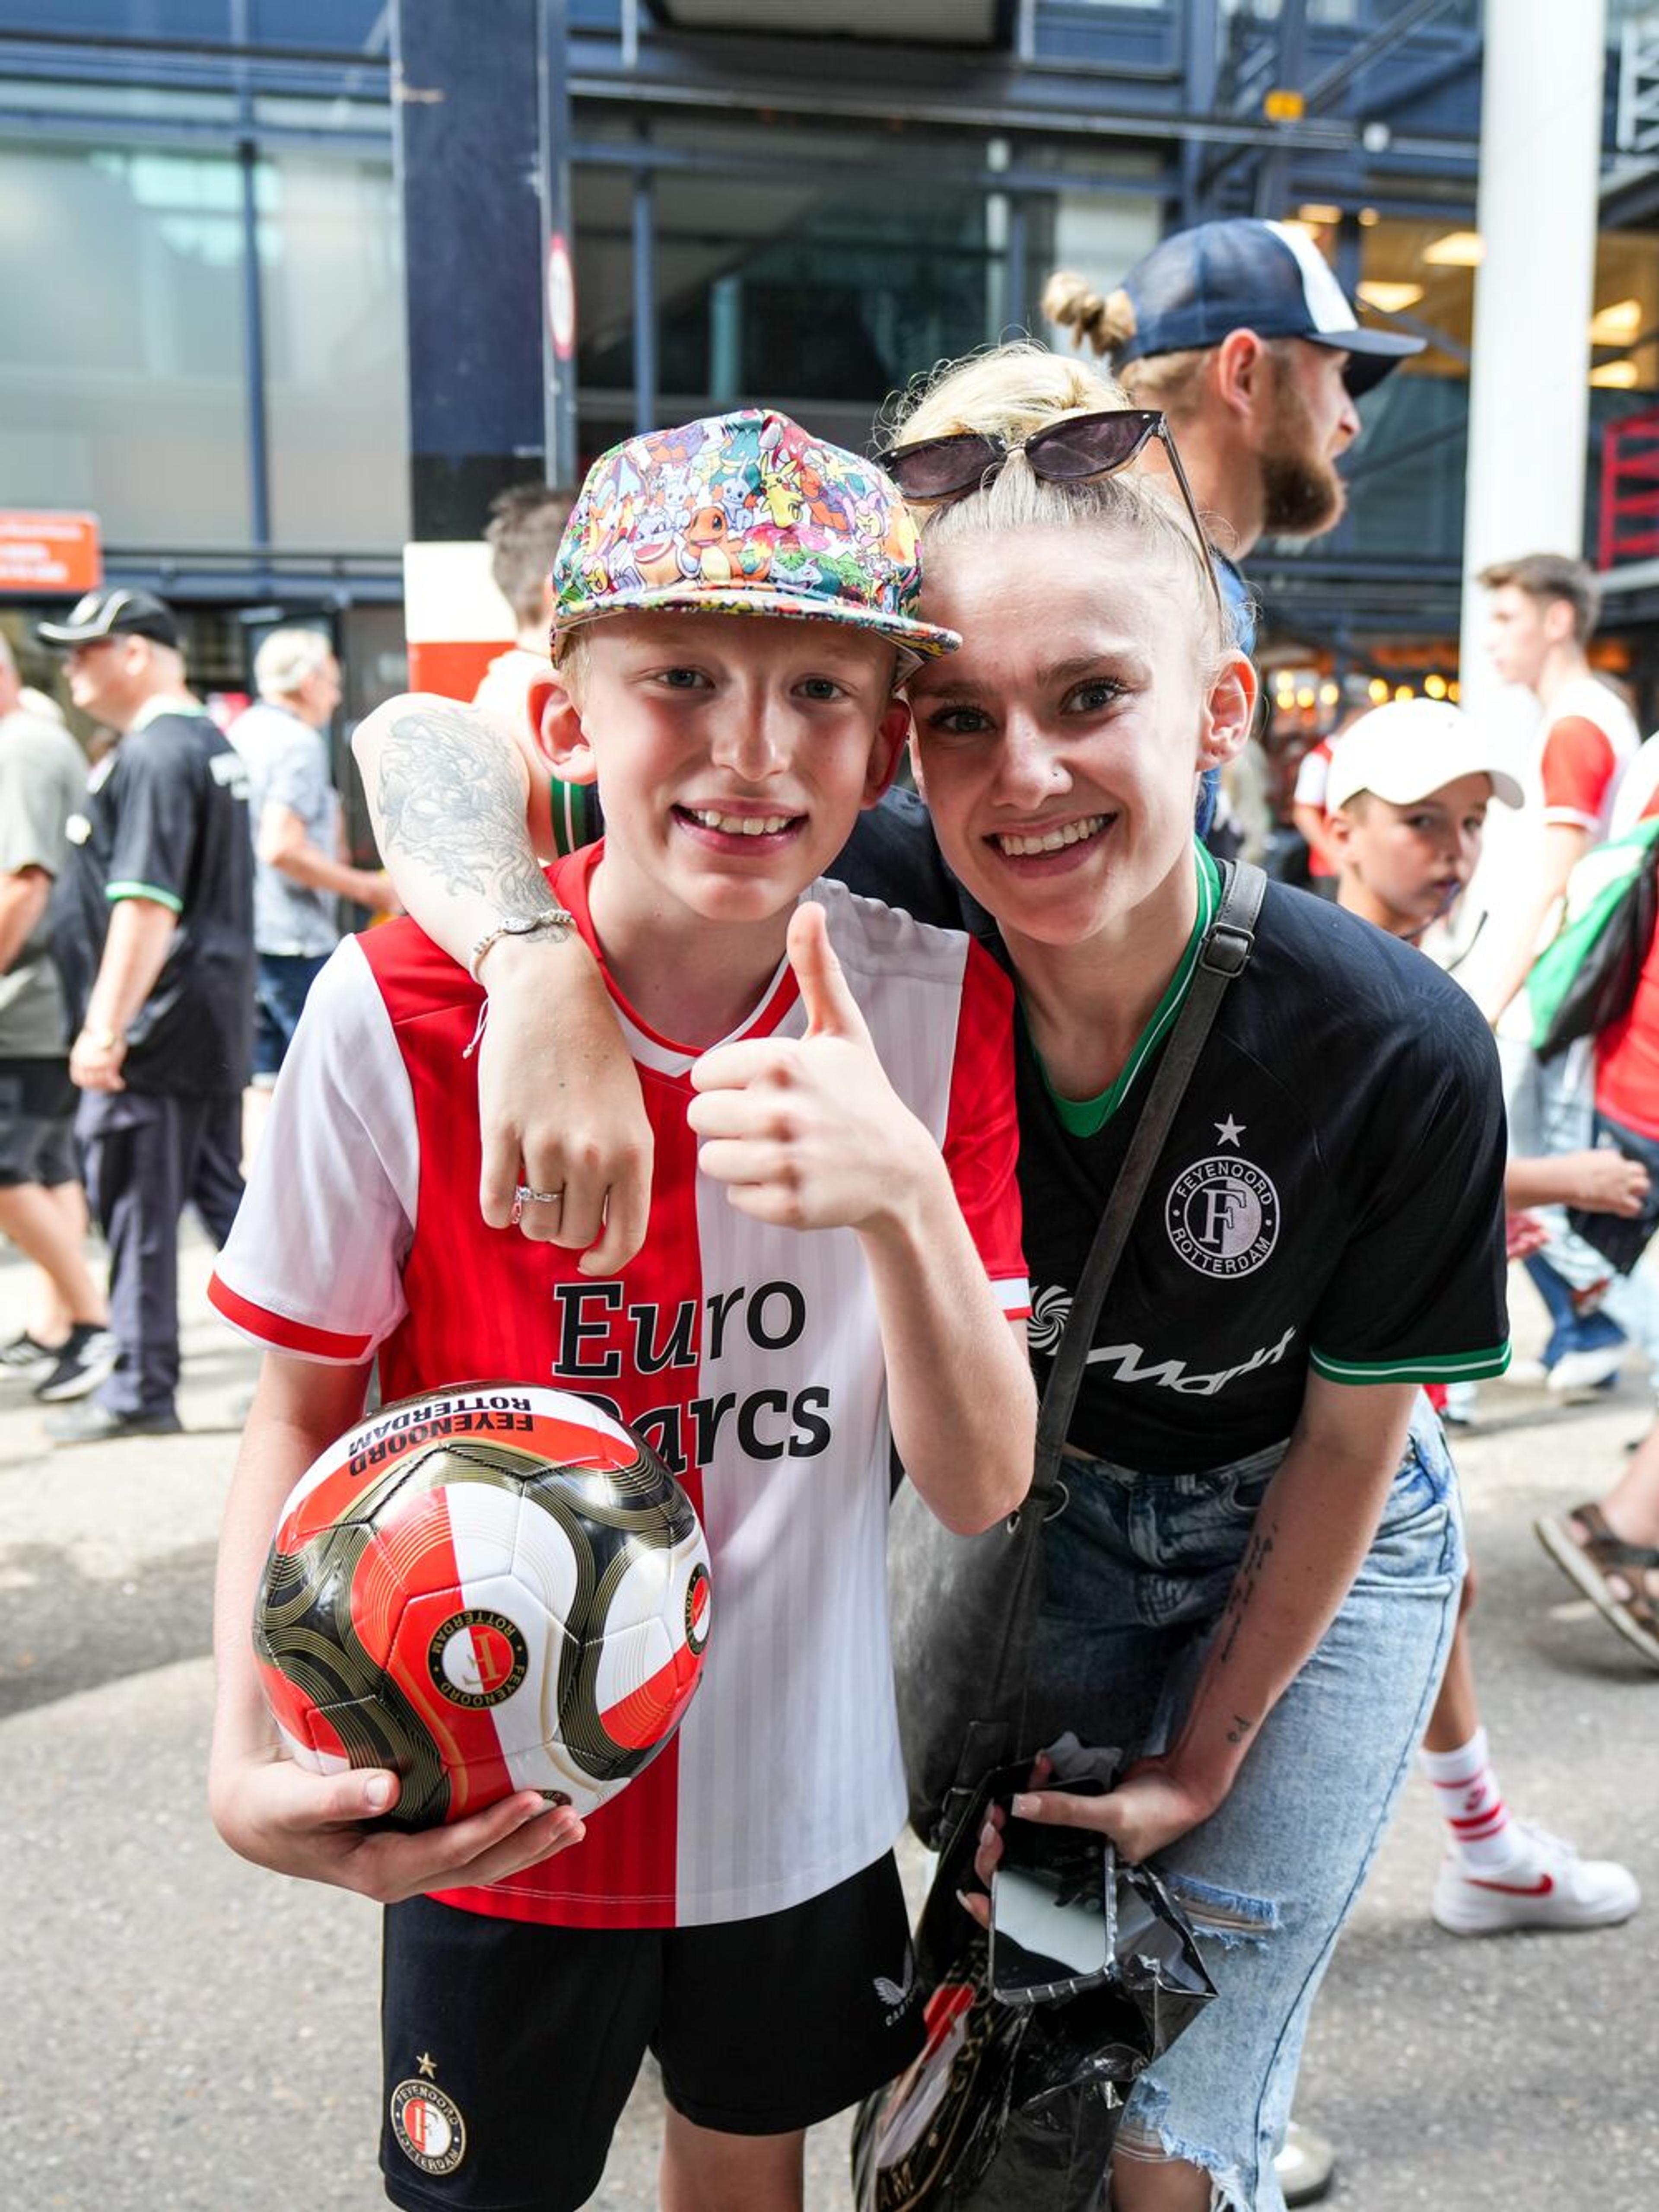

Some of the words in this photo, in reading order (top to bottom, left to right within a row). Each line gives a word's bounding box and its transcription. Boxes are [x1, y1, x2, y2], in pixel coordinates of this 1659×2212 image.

[1176, 1161, 1273, 1206] FEYENOORD
[1172, 1227, 1271, 1274] ROTTERDAM
[552, 1280, 806, 1378] Euro
[348, 1396, 532, 1457] ROTTERDAM
[349, 1411, 534, 1477] FEYENOORD
[566, 1386, 832, 1475] arcs
[431, 1611, 518, 1654] ROTTERDAM
[441, 1665, 525, 1706] FEYENOORD
[396, 2085, 460, 2126] FEYENOORD
